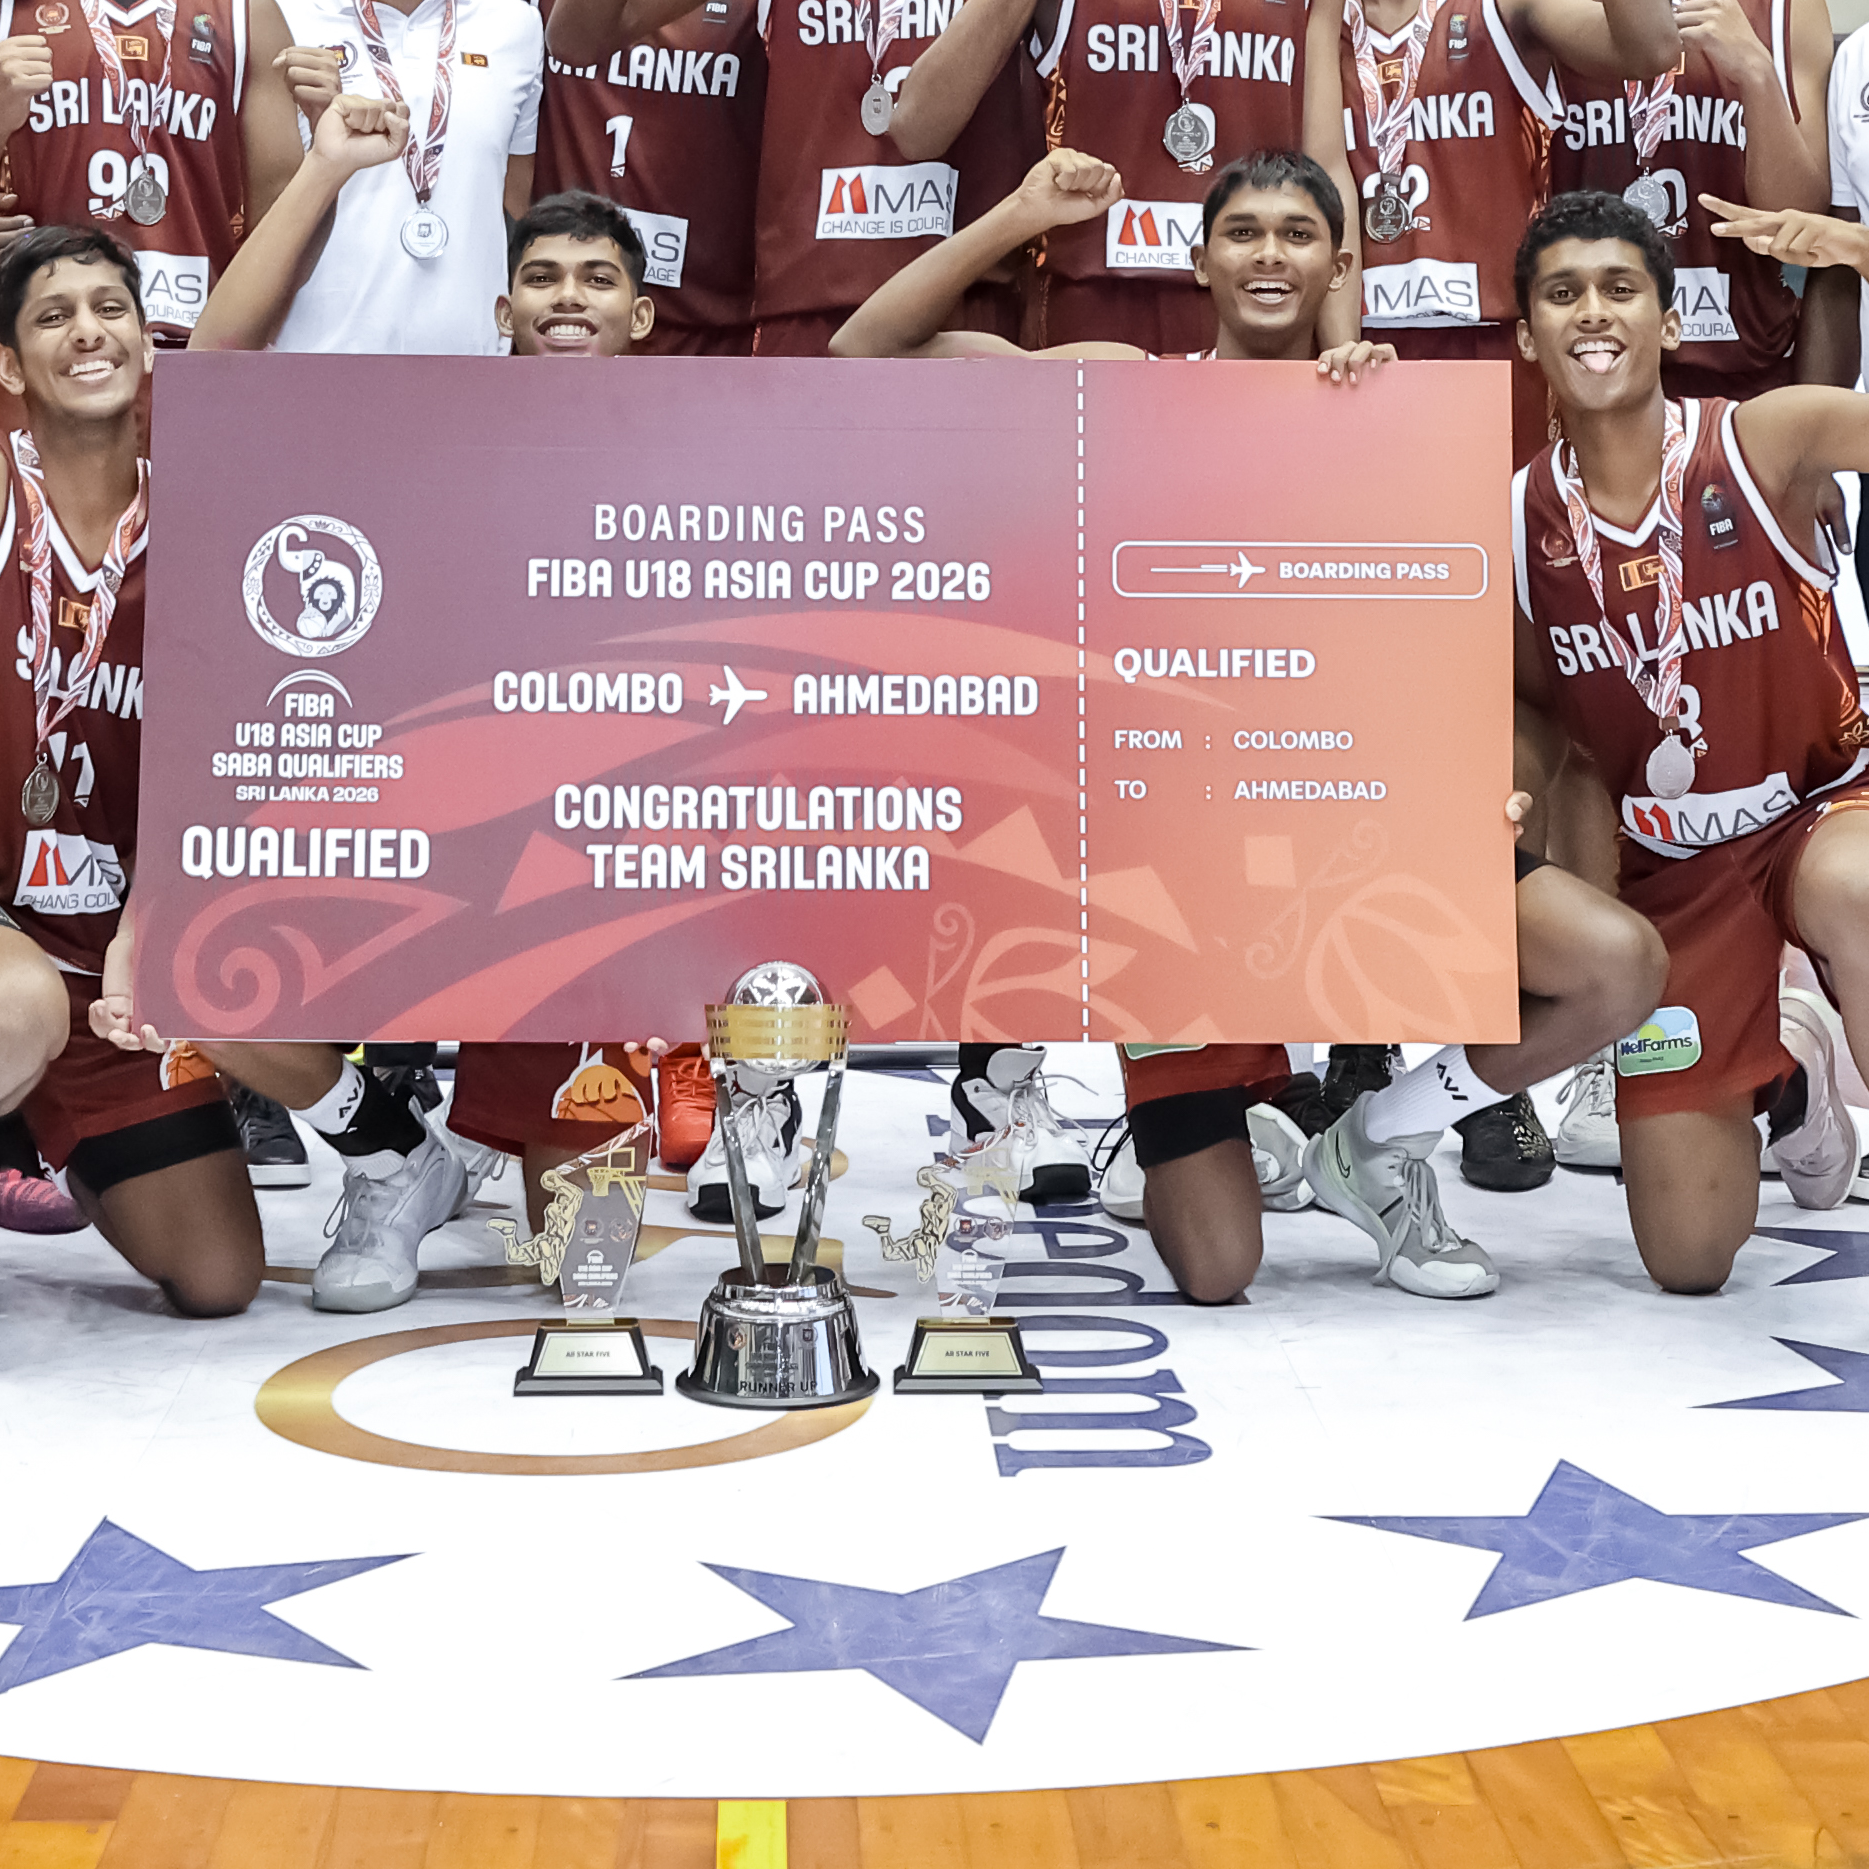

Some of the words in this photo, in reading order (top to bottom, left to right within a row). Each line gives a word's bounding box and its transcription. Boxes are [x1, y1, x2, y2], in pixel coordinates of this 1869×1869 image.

[706, 2, 728, 14] FIBA
[191, 38, 212, 54] FIBA
[1087, 23, 1159, 73] SRI
[1172, 29, 1296, 86] ANKA
[607, 43, 741, 98] LANKA
[29, 77, 90, 133] SRI
[1564, 97, 1626, 151] SRI
[1662, 93, 1748, 152] ANK
[605, 114, 634, 178] 1
[822, 220, 886, 235] CHANGE
[890, 219, 903, 234] IS
[1115, 251, 1180, 265] CHANGE
[145, 269, 202, 305] AS
[1374, 274, 1474, 314] MAS
[145, 304, 200, 324] OURAGE
[1682, 322, 1735, 337] COURA
[595, 503, 805, 543] BOARDING
[824, 505, 926, 544] PASS
[1709, 518, 1734, 536] FIBA
[527, 557, 613, 599] FIBA
[624, 558, 693, 600] U18
[704, 559, 793, 601] ASIA
[803, 560, 880, 601] CUP
[890, 560, 991, 602] 2026
[1279, 561, 1392, 580] BOARDING
[1396, 561, 1451, 581] PASS
[1626, 580, 1780, 664] LNKA
[1113, 647, 1317, 684] QUALIFIED
[284, 693, 335, 718] FIBA
[493, 670, 683, 715] COLOMBO
[793, 673, 1039, 716] AHMEDABAD
[235, 722, 276, 748] U18
[280, 722, 333, 748] ASIA
[337, 723, 383, 749] CUP
[1114, 729, 1183, 750] FROM
[1205, 734, 1212, 750] :
[1233, 729, 1354, 751] COLOMBO
[212, 752, 273, 778] SABA
[277, 753, 404, 780] QUALIFIERS
[235, 785, 266, 802] SRI
[269, 785, 330, 802] LANKA
[332, 786, 379, 803] 2026
[554, 783, 963, 832] CONGRATULATIONS
[1113, 779, 1148, 800] TO
[1205, 784, 1212, 801] :
[1233, 779, 1388, 801] AHMEDABAD
[181, 824, 431, 880] QUALIFIED
[585, 843, 706, 890] TEAM
[720, 843, 930, 891] SRILANKA
[740, 1382, 795, 1393] RUNNER
